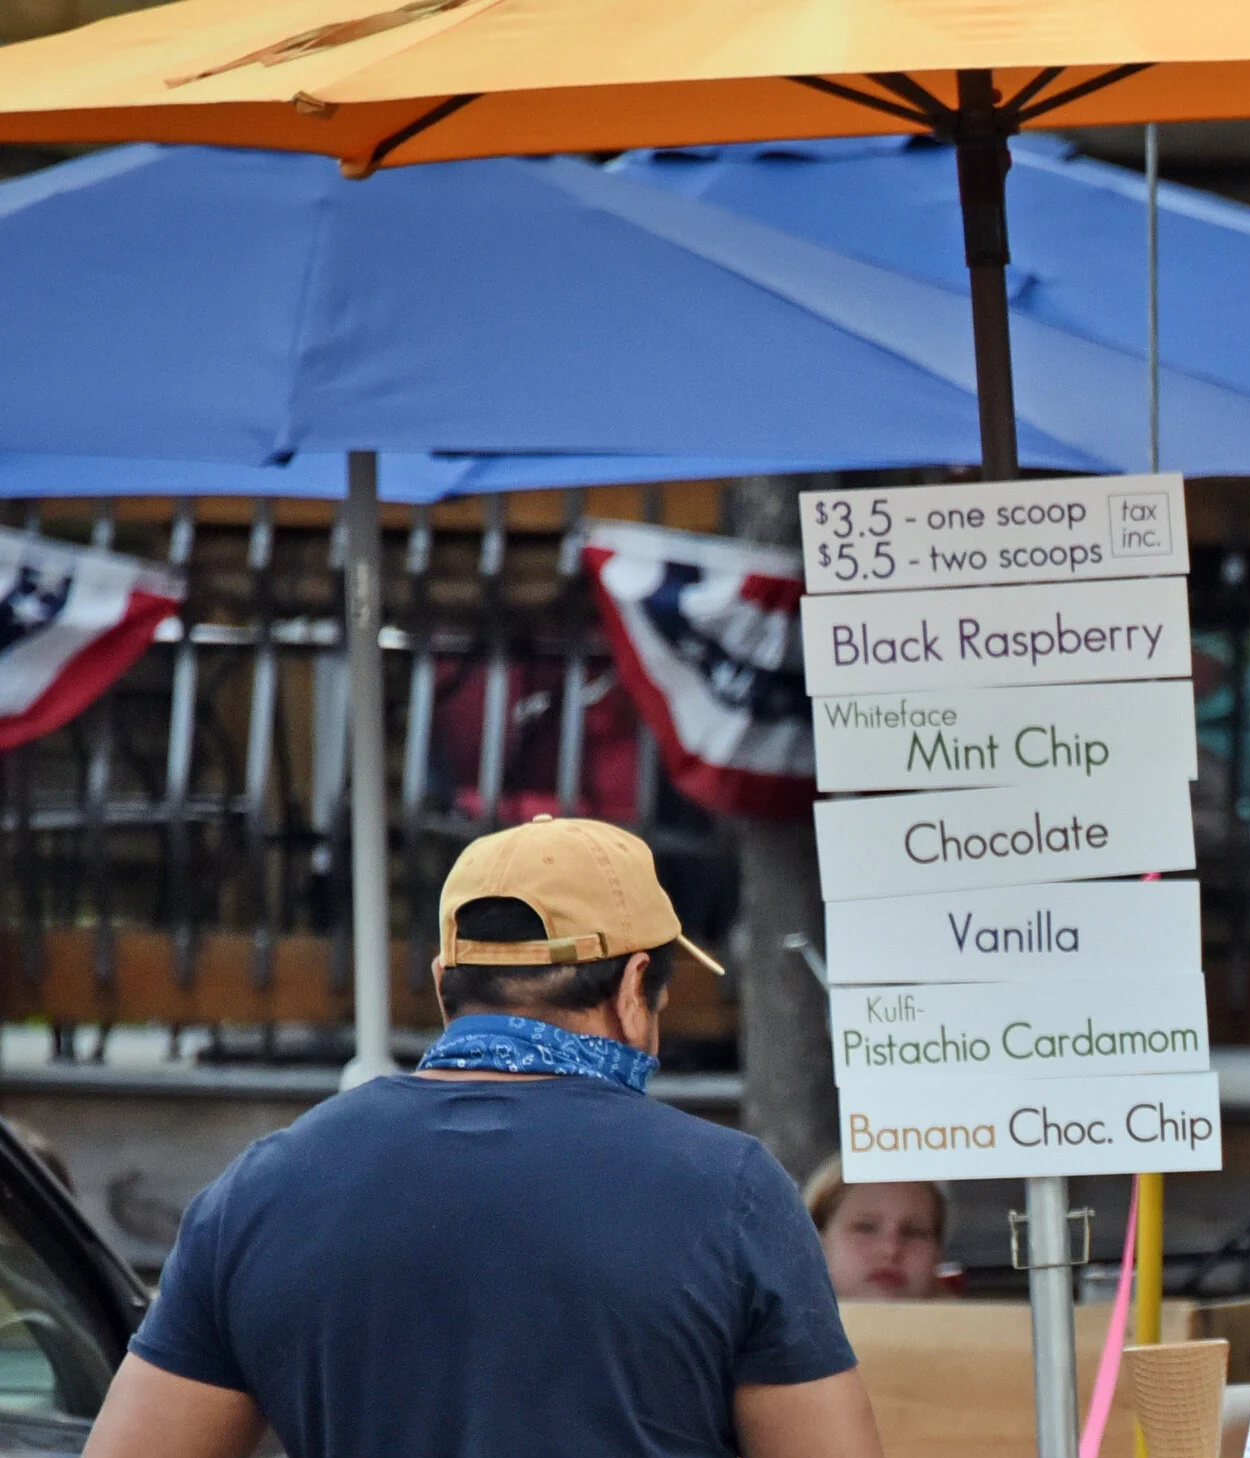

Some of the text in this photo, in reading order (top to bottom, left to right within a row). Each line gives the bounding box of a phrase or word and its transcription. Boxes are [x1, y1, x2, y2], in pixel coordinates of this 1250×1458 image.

[815, 499, 892, 539] $3.5
[927, 506, 985, 531] one
[997, 500, 1087, 530] scoop
[1121, 500, 1158, 522] tax
[1121, 526, 1161, 550] inc.
[817, 541, 896, 582] $5.5
[930, 545, 988, 572] two
[999, 542, 1103, 574] scoops
[832, 612, 1164, 667] Black Raspberry
[823, 700, 958, 728] Whiteface
[907, 725, 1110, 777] Mint Chip
[904, 812, 1109, 864] Chocolate
[948, 910, 1080, 954] Vanilla
[843, 1018, 1199, 1067] Pistachio Cardamom
[849, 1101, 1213, 1153] Banana Choc. Chip
